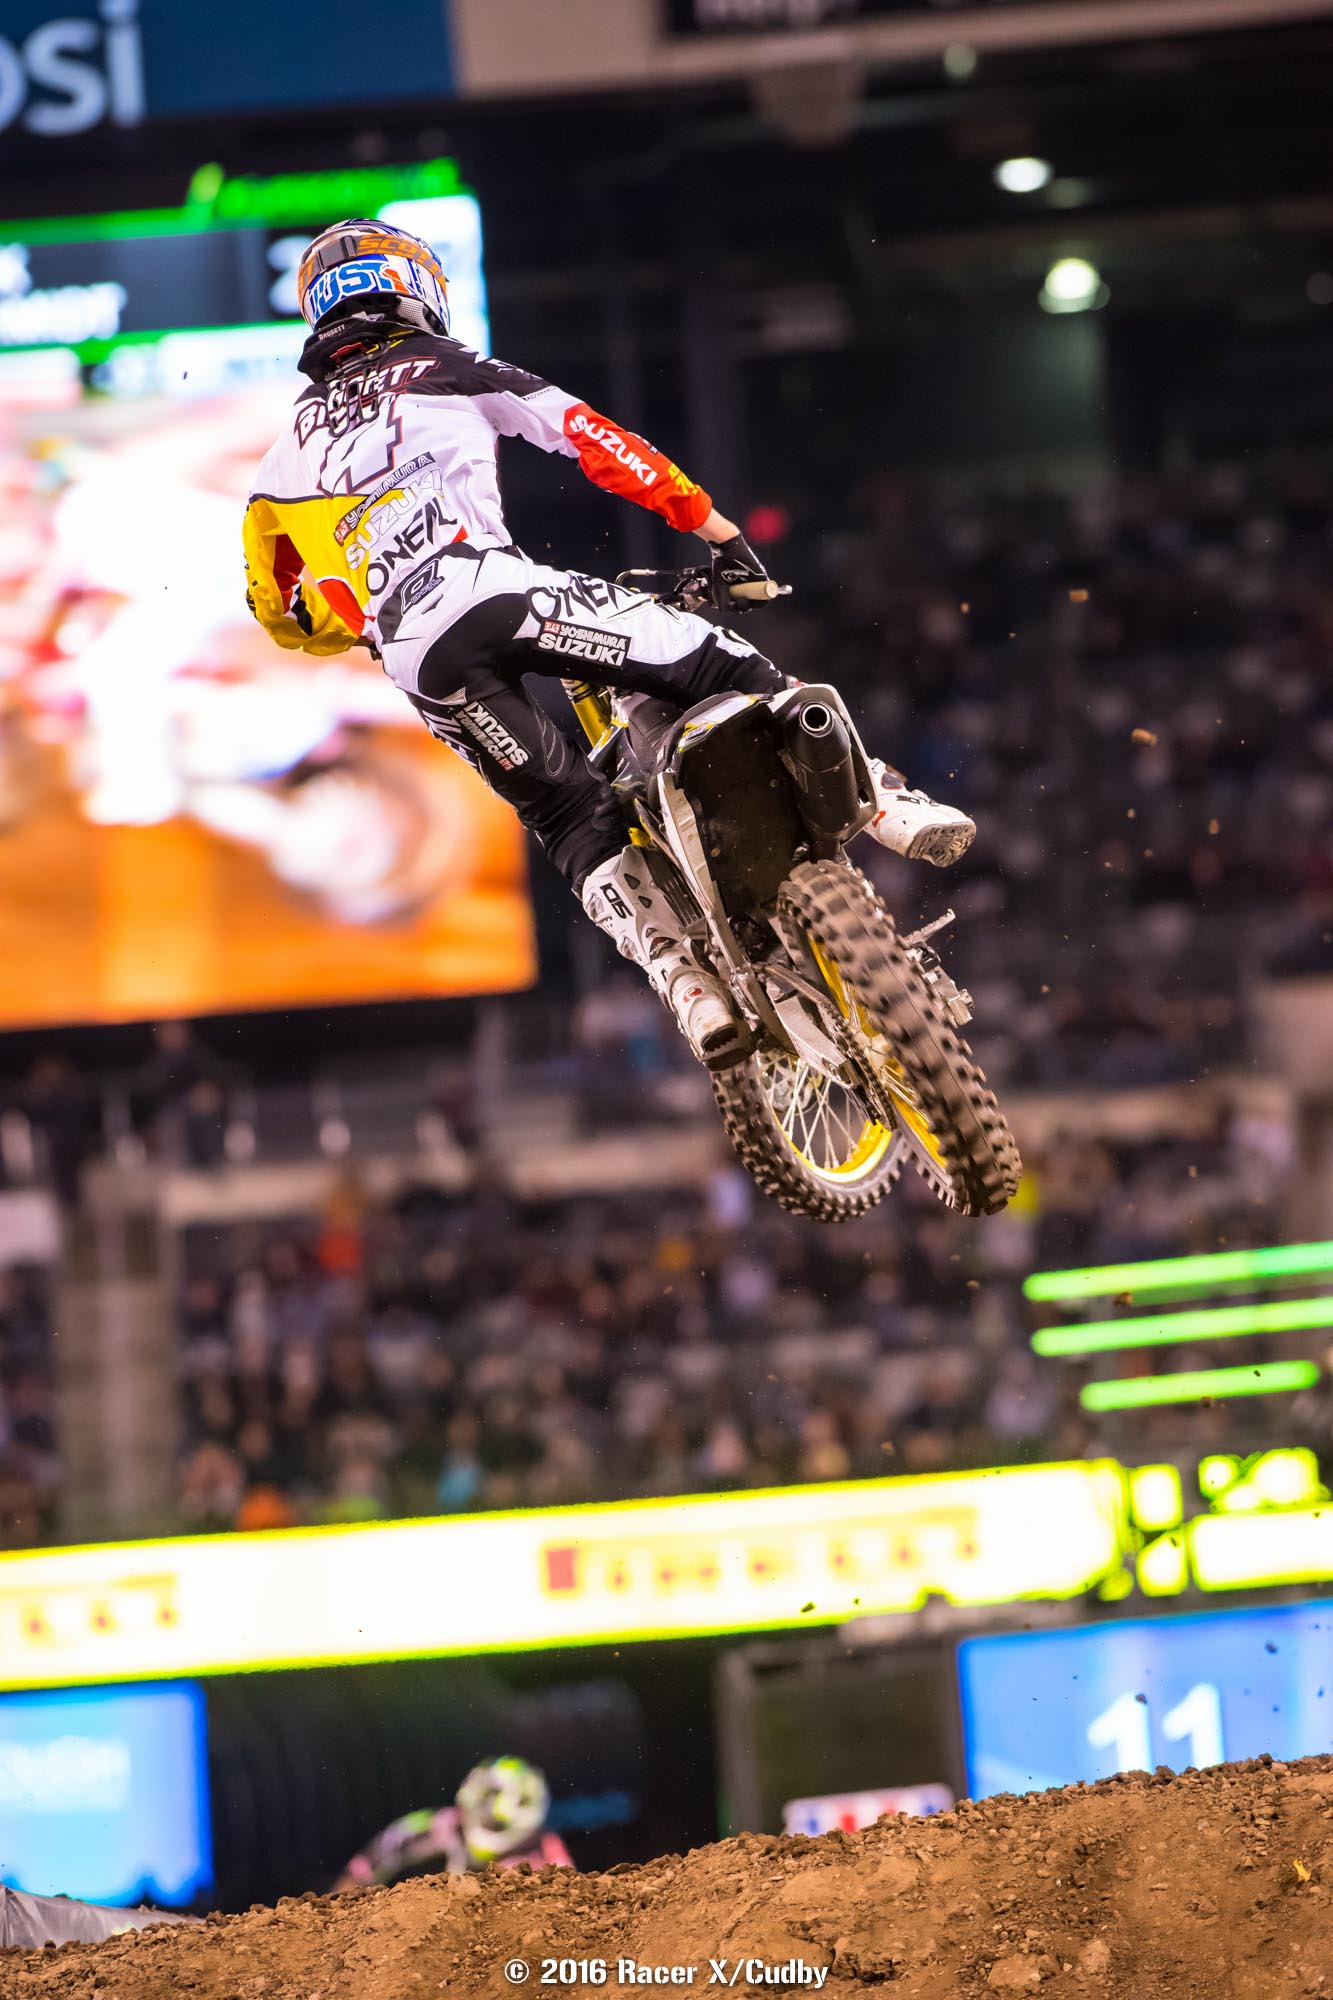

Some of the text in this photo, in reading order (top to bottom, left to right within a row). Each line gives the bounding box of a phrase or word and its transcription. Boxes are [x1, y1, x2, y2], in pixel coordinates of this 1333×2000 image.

[569, 414, 658, 486] SUZUKI
[346, 468, 443, 570] SUZUKI
[525, 575, 638, 621] O'NEA
[538, 632, 626, 667] SUZUKI
[560, 624, 627, 650] YOSHIMURA
[463, 700, 529, 767] SUZUKI
